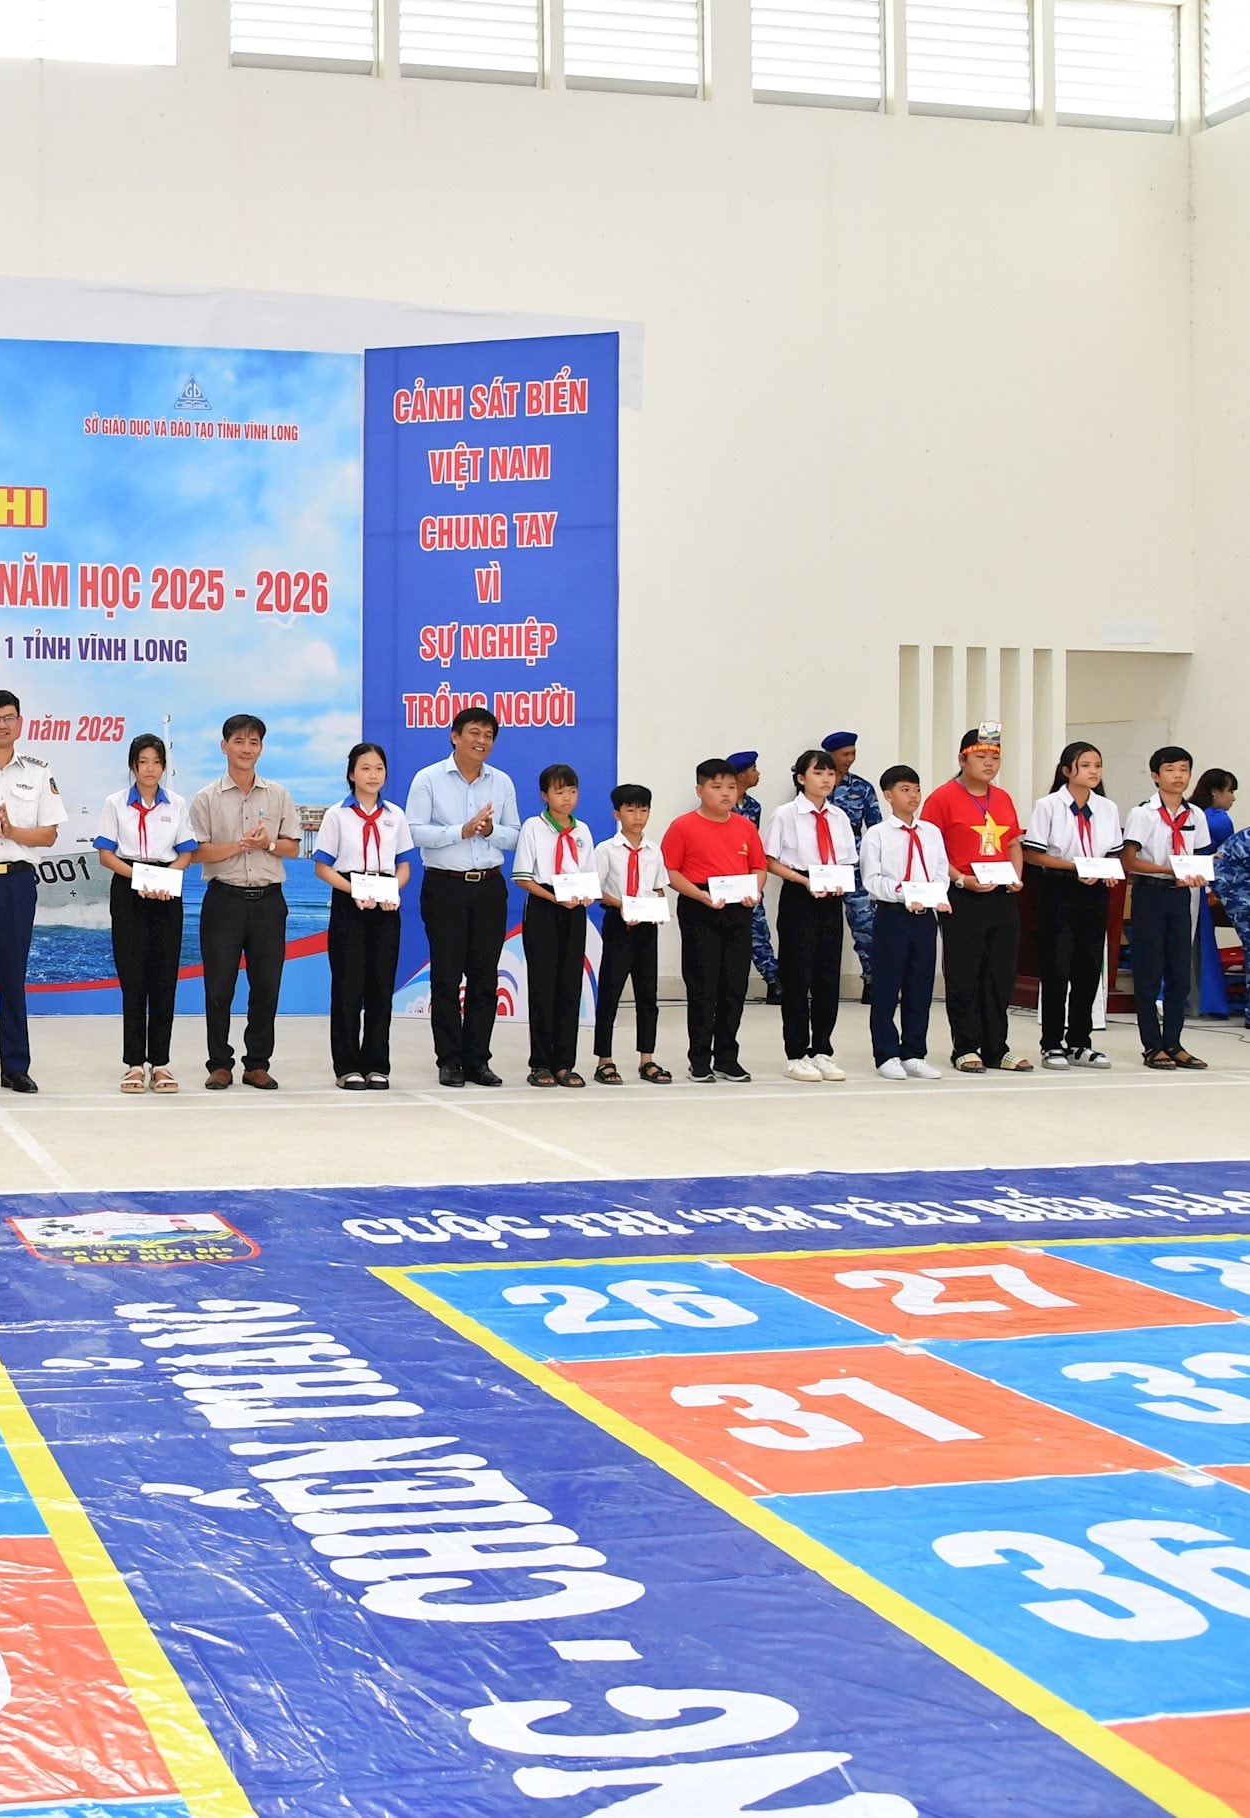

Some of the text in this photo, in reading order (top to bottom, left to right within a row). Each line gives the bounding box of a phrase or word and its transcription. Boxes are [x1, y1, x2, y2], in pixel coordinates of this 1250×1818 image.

[393, 365, 588, 424] CẢNH SÁT BIỂN
[84, 413, 299, 442] SỞ GIÁO DỤC VÀ ĐÀO TẠO TỈNH VĨNH LONG
[428, 441, 551, 491] VIỆT NAM
[419, 511, 558, 551] CHUNG TAY
[79, 563, 142, 619] HỌC
[150, 567, 225, 612] 2025
[234, 586, 247, 600] -
[255, 570, 330, 615] 2026
[475, 561, 502, 603] VÌ
[4, 635, 15, 659] 1
[23, 628, 72, 661] TỈNH
[77, 632, 128, 663] VĨNH
[133, 638, 189, 663] LONG
[419, 616, 558, 668] SỰ NGHIỆP
[28, 715, 71, 742] năm
[77, 716, 126, 743] 2025
[494, 682, 576, 728] NGƯỜI
[35, 856, 91, 885] 001
[342, 1210, 549, 1249] CUỘC
[540, 1209, 695, 1238] THI
[836, 1196, 981, 1228] YÊU
[501, 1279, 759, 1334] 26
[834, 1263, 1080, 1316] 27
[670, 1376, 986, 1452] 31
